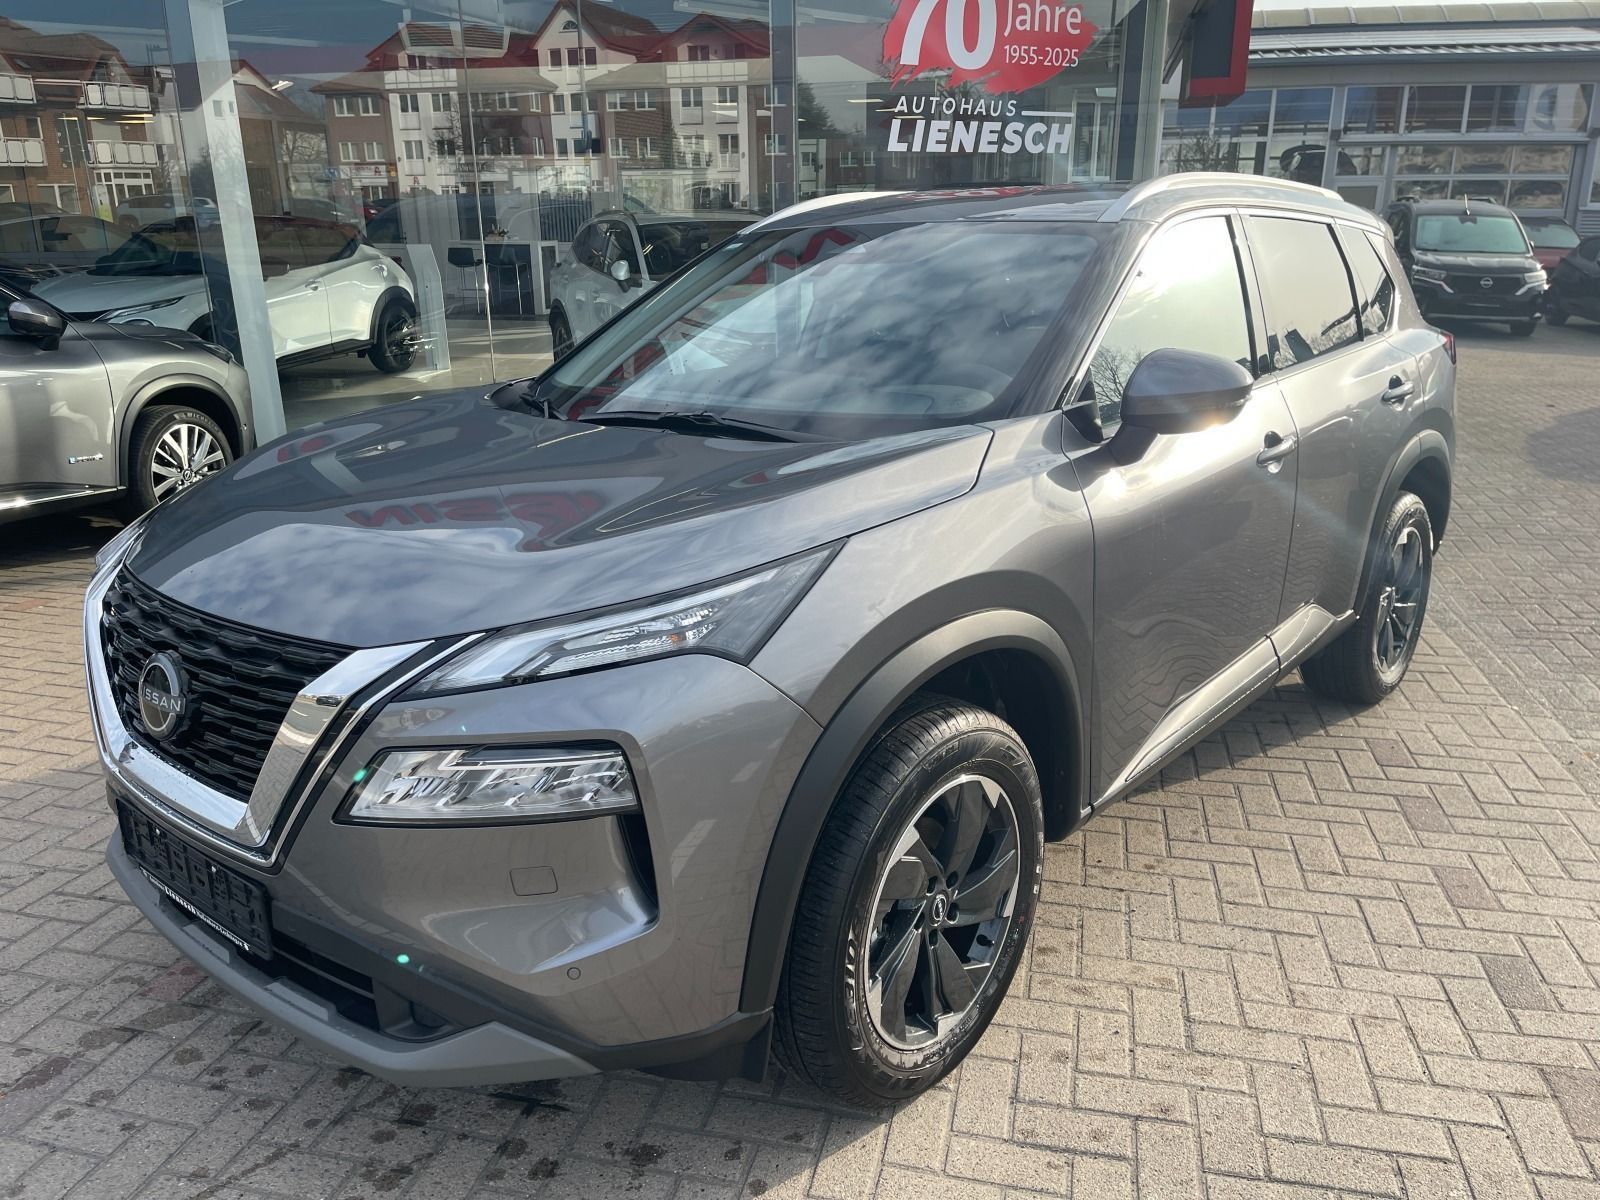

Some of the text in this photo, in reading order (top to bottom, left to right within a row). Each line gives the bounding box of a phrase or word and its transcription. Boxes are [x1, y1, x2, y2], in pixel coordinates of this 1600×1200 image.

[900, 0, 1082, 70] 70 Jahre
[1003, 44, 1079, 68] 1955-2025
[894, 95, 1017, 117] AUTOHAUS
[887, 118, 1073, 154] LIENESCH
[142, 685, 181, 712] ISSAN
